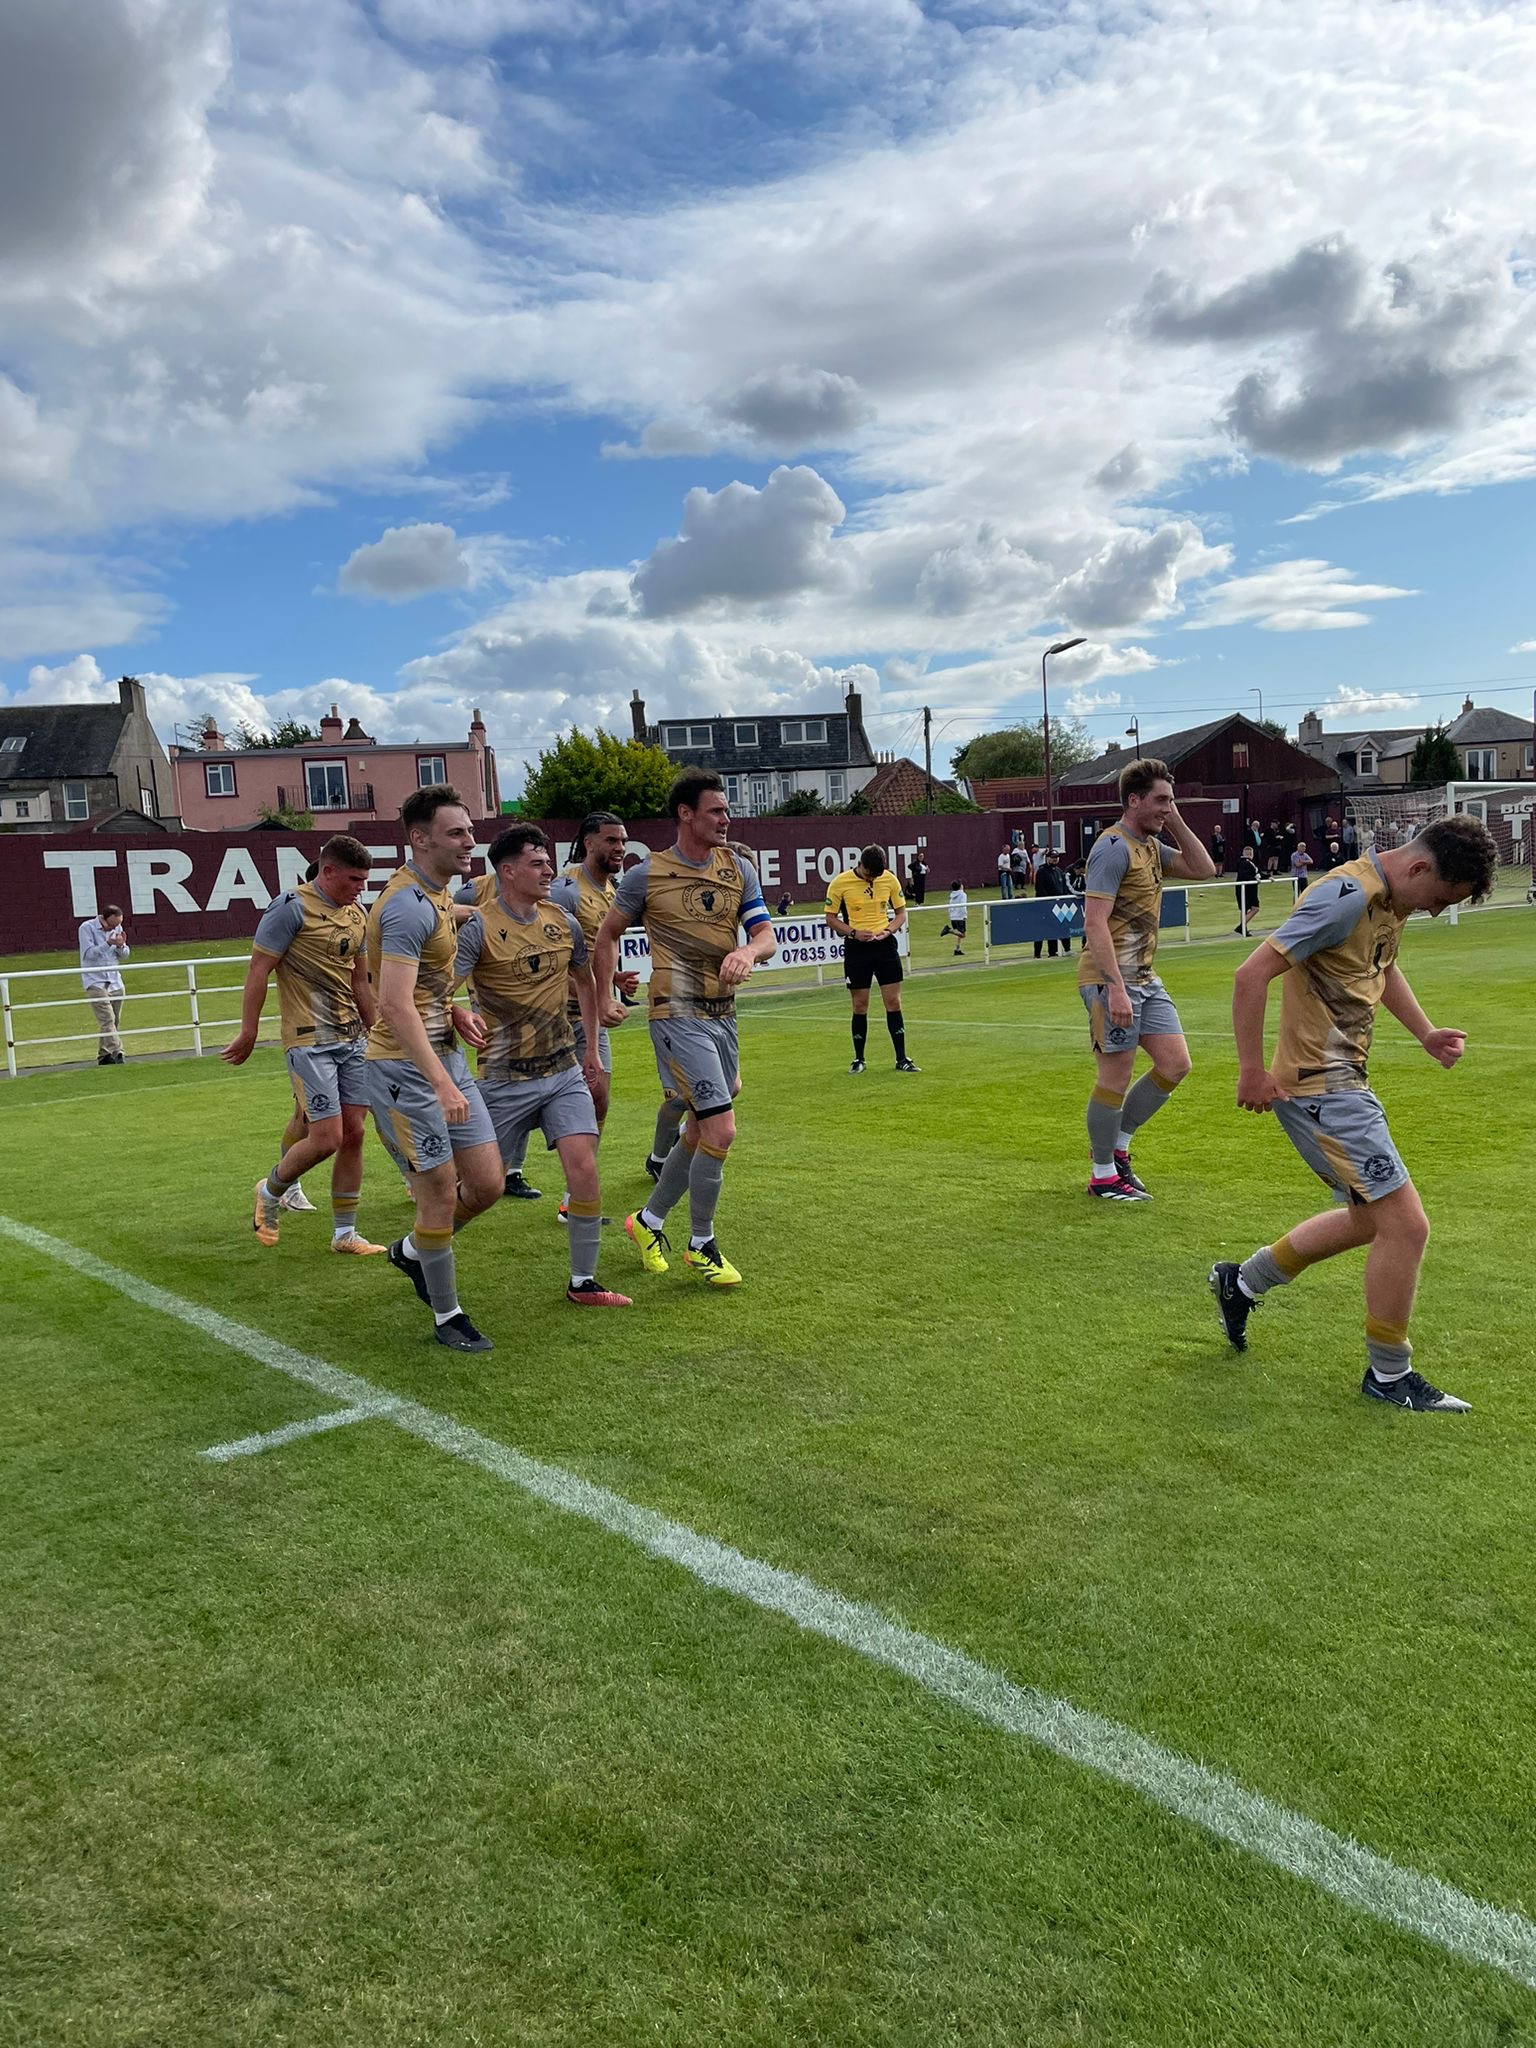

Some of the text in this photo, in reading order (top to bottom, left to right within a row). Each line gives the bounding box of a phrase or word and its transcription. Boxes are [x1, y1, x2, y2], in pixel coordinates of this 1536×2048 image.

[1501, 803, 1534, 814] BIG
[1503, 813, 1531, 840] T
[782, 946, 826, 963] 07835
[830, 944, 846, 962] 96
